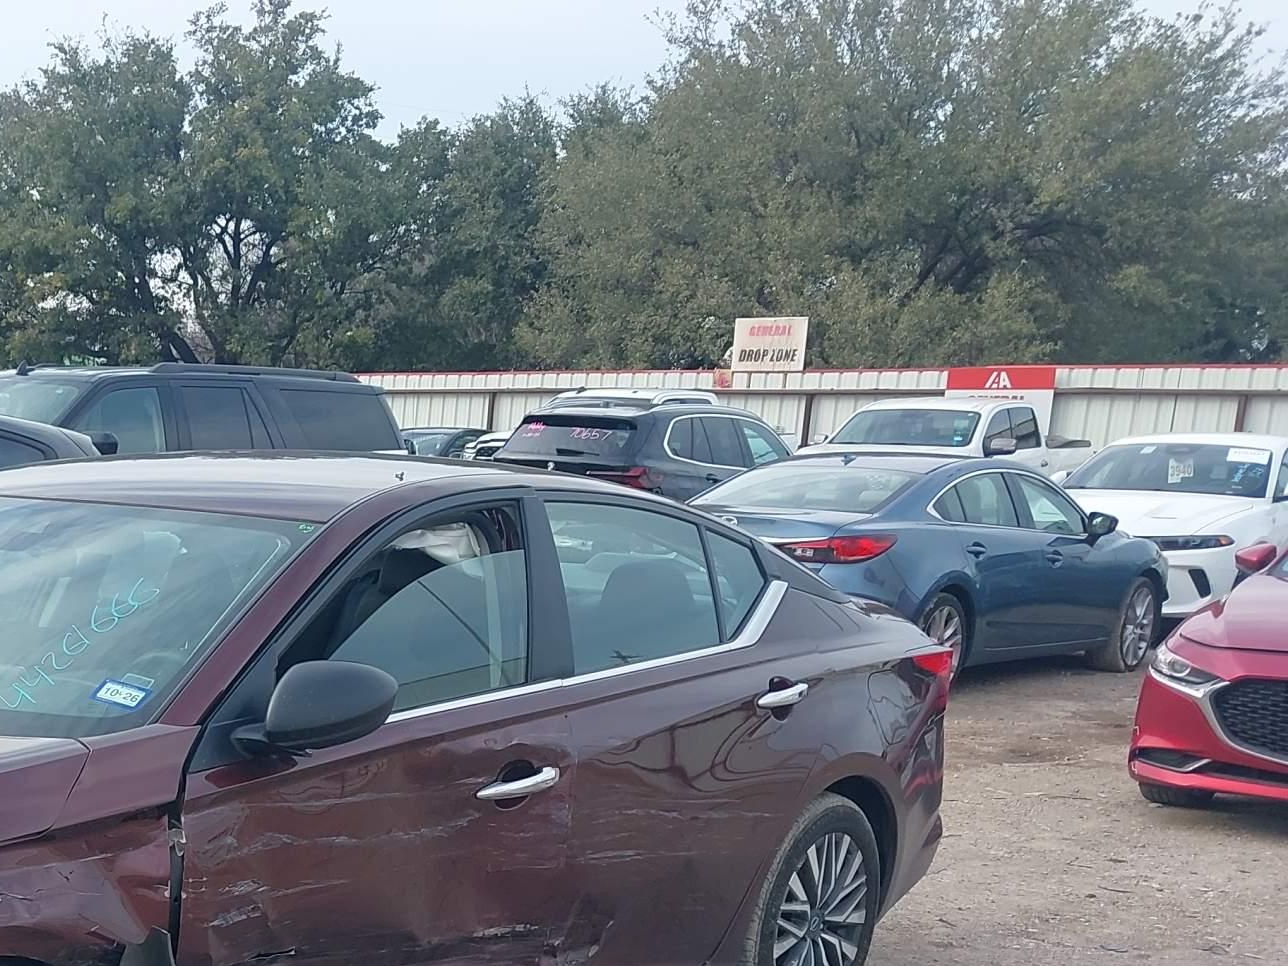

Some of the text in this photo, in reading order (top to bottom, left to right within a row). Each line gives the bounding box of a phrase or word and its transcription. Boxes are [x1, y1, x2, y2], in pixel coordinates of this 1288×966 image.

[748, 324, 793, 337] GENERAL
[738, 348, 798, 363] DROP ZONE
